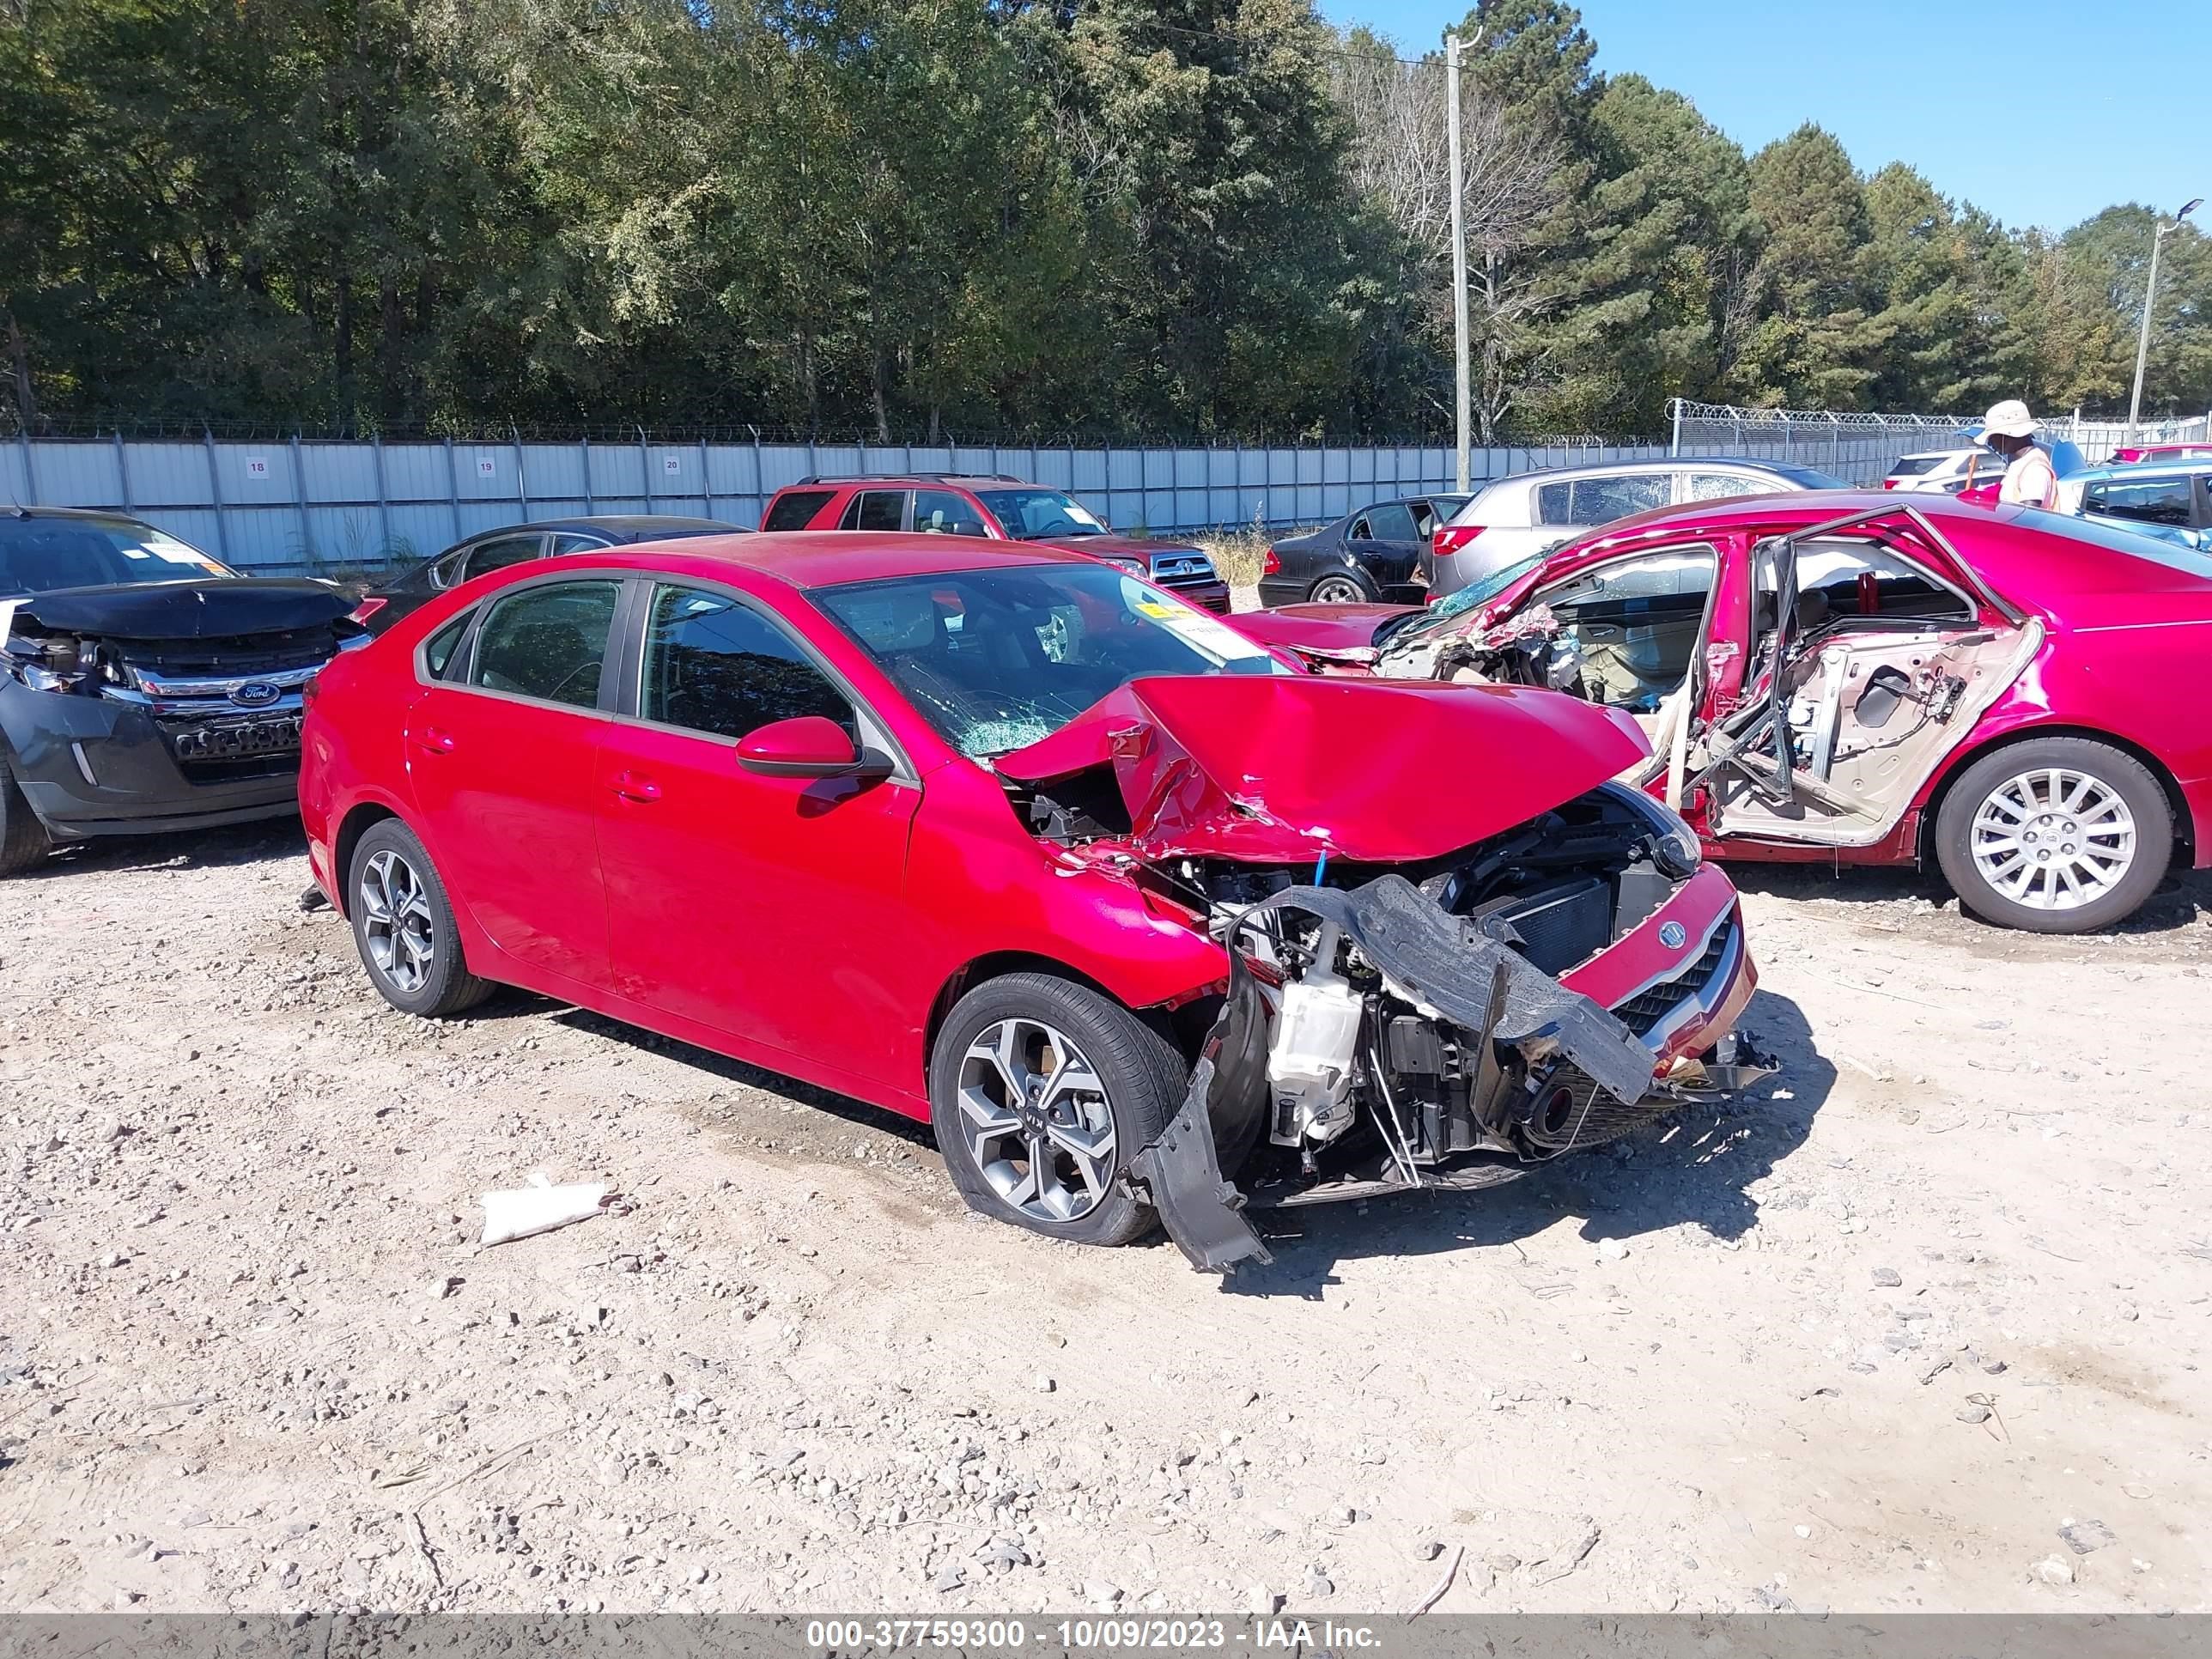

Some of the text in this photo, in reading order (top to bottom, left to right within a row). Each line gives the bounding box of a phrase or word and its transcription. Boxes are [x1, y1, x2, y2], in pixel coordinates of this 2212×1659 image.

[250, 463, 264, 471] 18
[481, 463, 492, 471] 19
[245, 686, 270, 698] Ford
